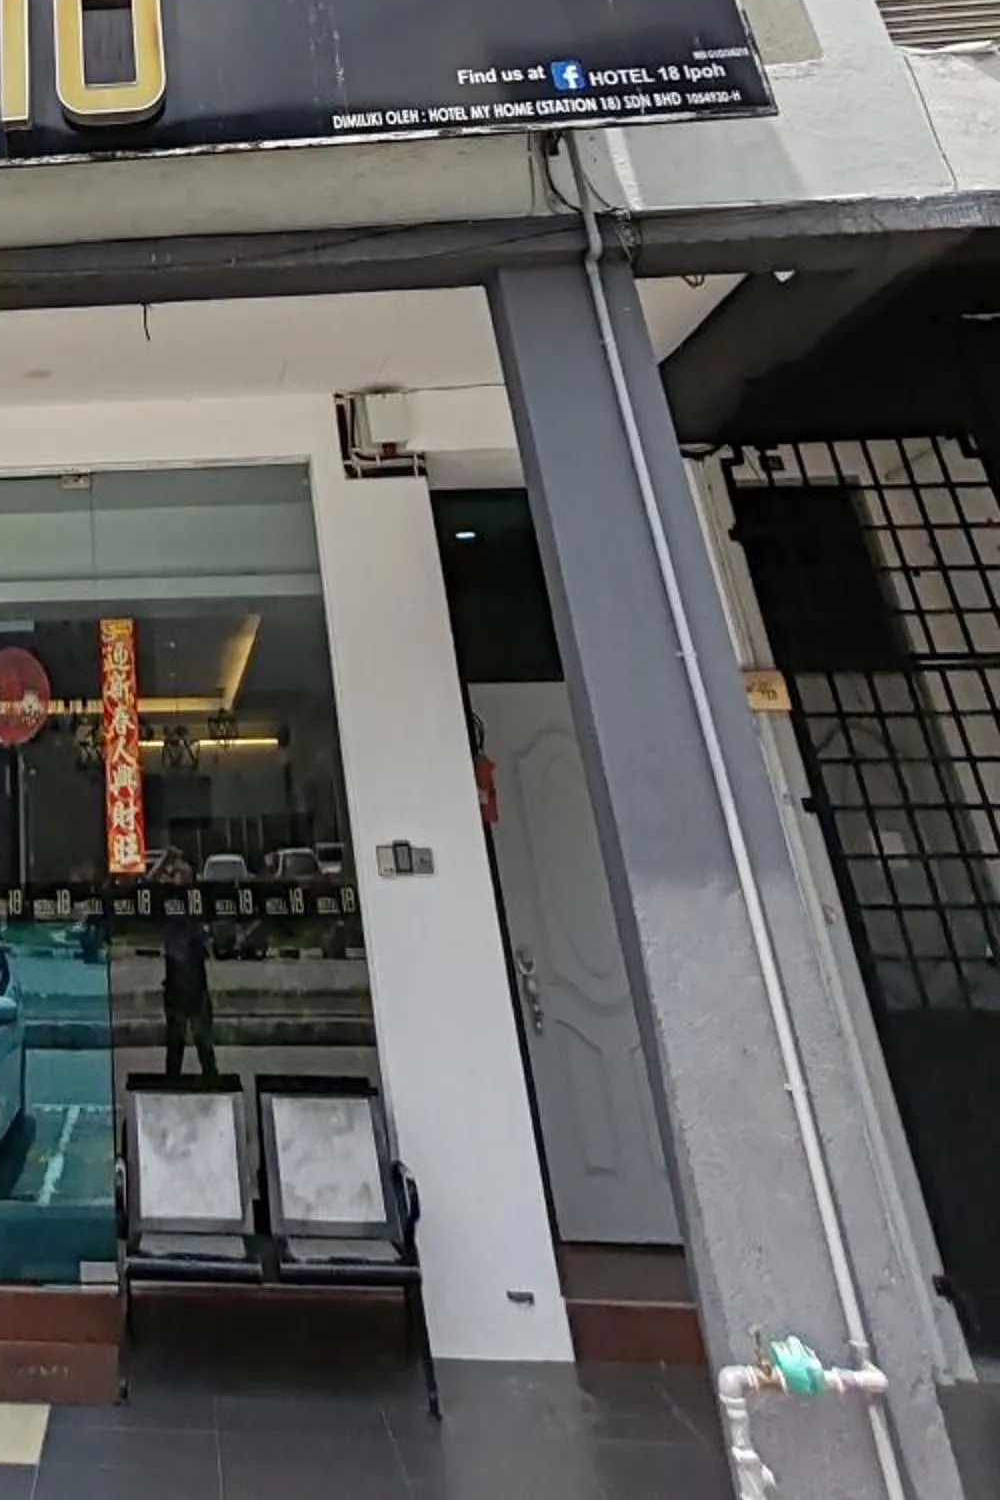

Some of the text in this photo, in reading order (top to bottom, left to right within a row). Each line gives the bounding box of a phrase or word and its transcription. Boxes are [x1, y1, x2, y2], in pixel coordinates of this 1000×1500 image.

[457, 67, 498, 85] Find
[501, 68, 524, 82] us
[528, 64, 547, 80] at
[588, 67, 655, 88] HOTEL
[657, 65, 680, 82] 18
[683, 62, 727, 82] Ipoh
[332, 111, 383, 129] DIMILIKI
[385, 108, 420, 126] OLEH
[428, 105, 468, 123] HOTEL
[471, 104, 490, 119] MY
[493, 101, 534, 118] HOME
[535, 96, 601, 115] (STATION
[601, 96, 621, 112] 18)
[624, 93, 652, 110] SDN
[653, 91, 682, 108] BHD
